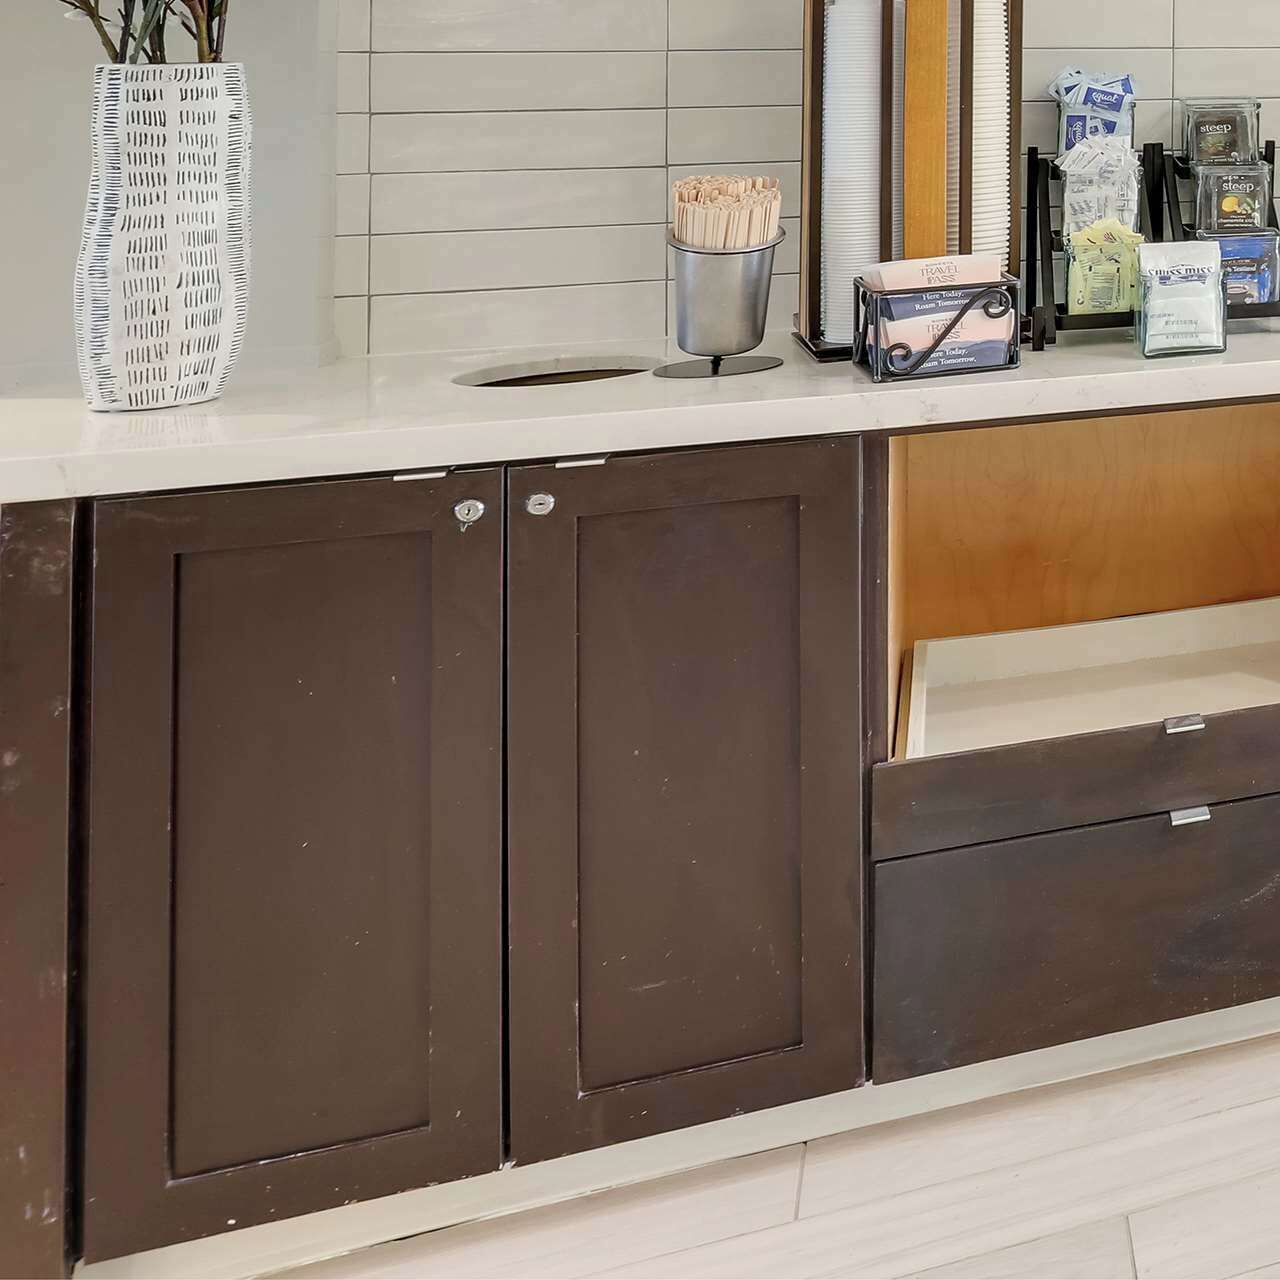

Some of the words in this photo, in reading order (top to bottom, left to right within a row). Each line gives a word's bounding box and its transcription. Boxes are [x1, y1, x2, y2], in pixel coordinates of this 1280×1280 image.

[1200, 123, 1232, 134] steep
[1222, 180, 1255, 193] steep
[914, 302, 936, 311] Roam
